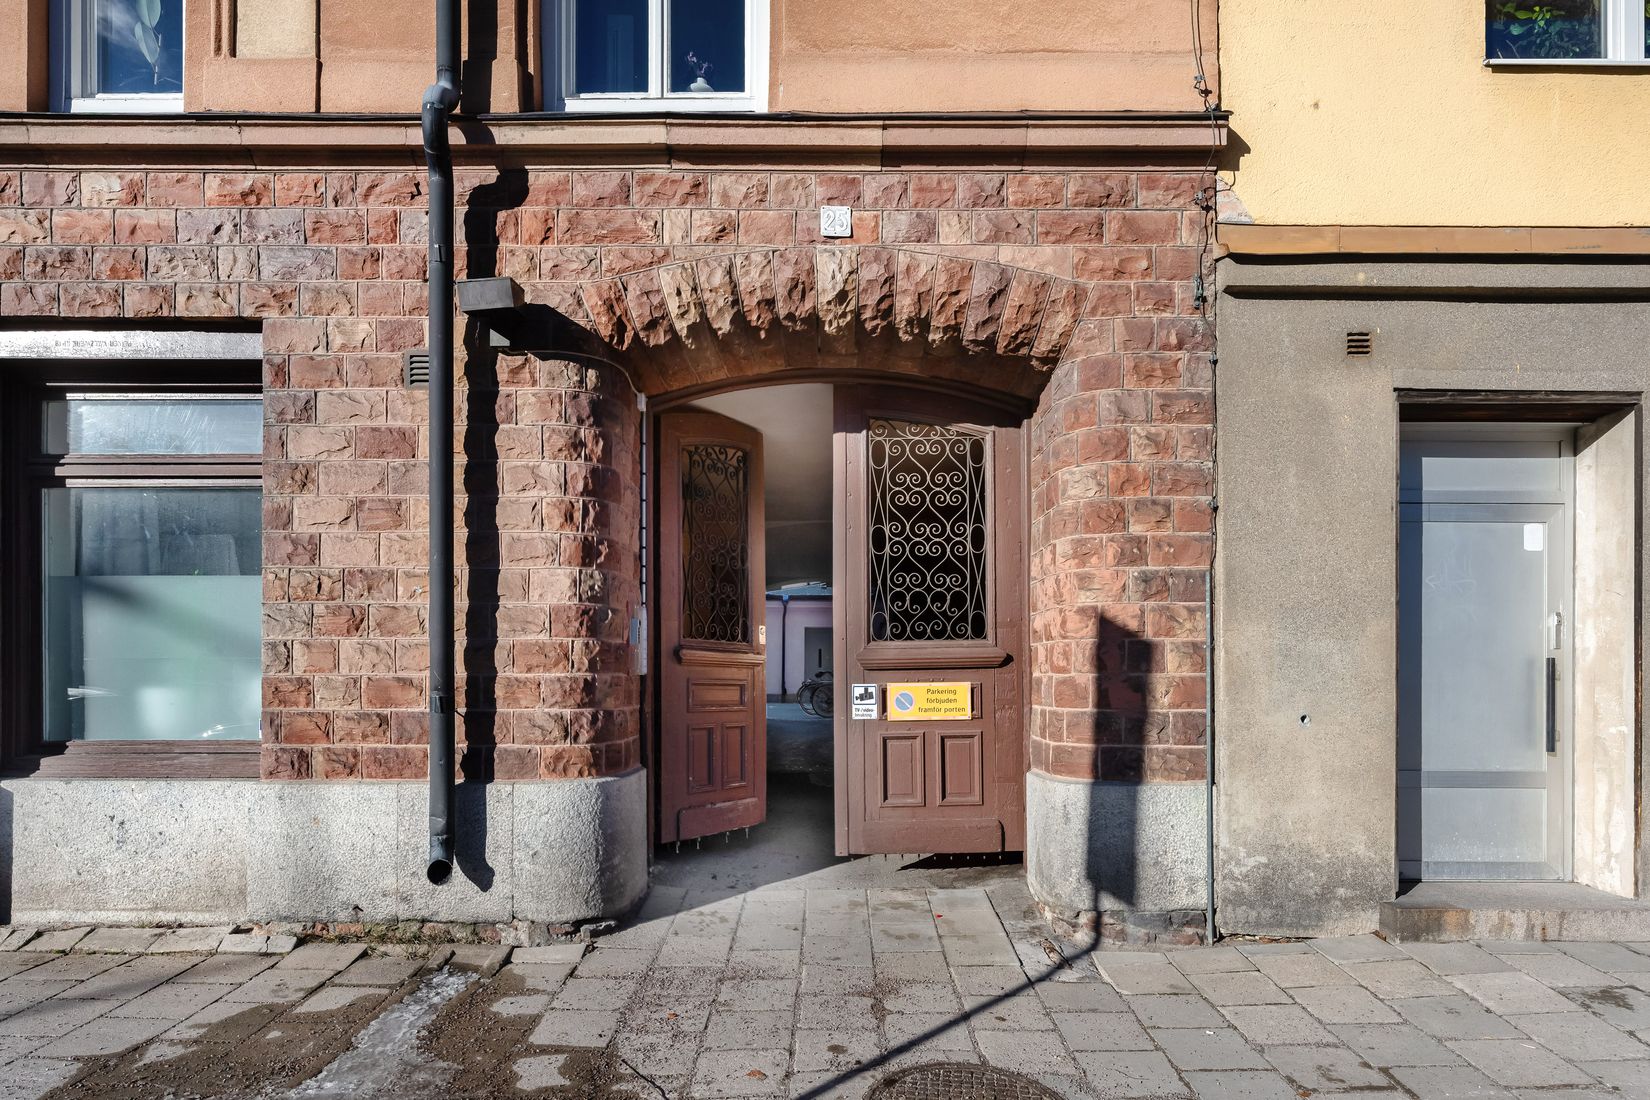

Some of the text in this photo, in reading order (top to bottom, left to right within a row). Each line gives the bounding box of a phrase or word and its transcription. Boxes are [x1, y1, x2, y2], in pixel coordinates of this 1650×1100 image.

[824, 210, 849, 231] 25
[926, 688, 957, 696] Parkering
[943, 706, 966, 714] porten
